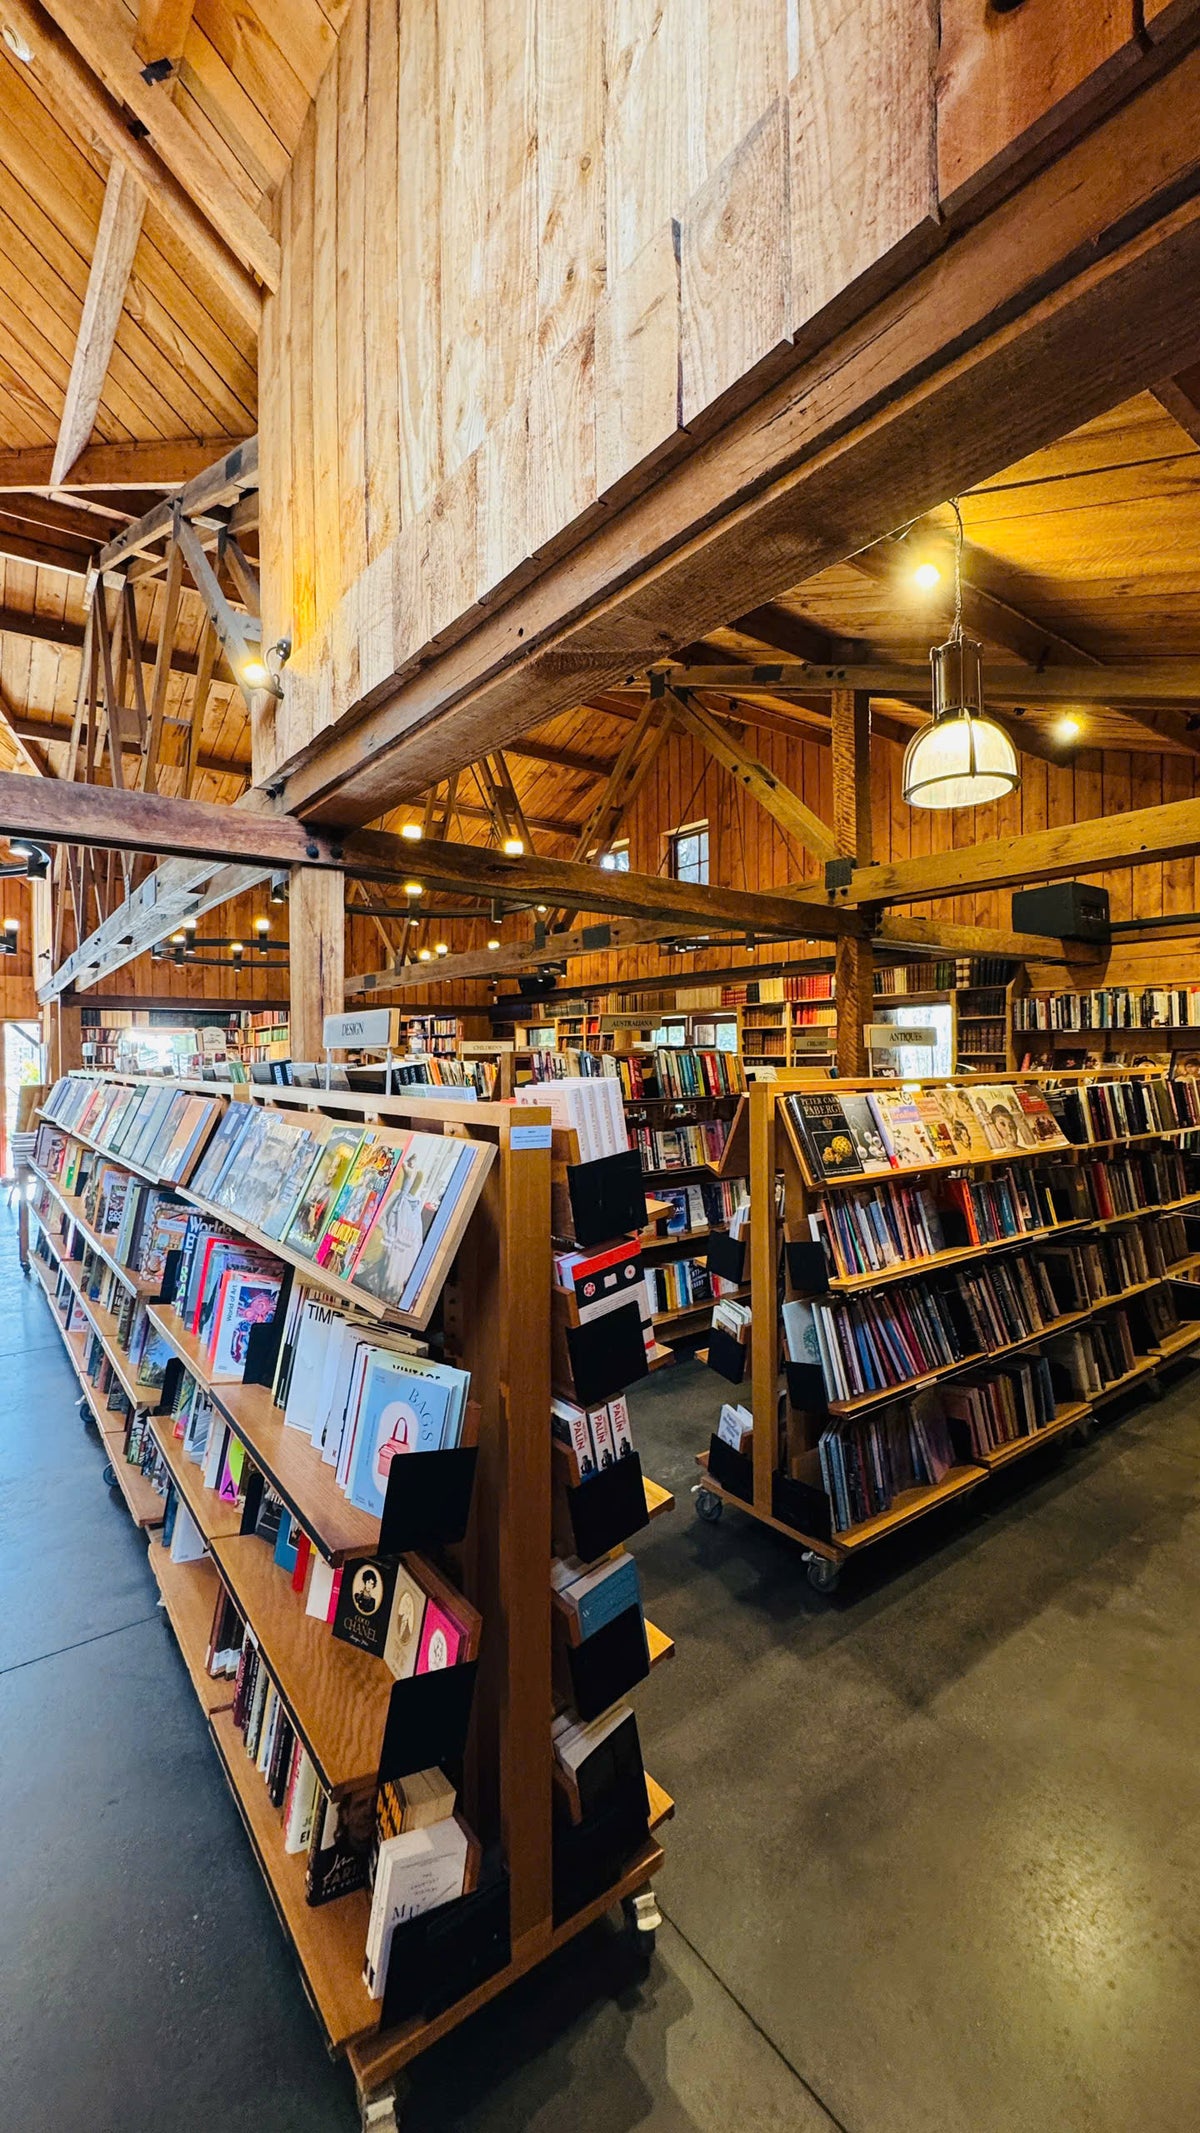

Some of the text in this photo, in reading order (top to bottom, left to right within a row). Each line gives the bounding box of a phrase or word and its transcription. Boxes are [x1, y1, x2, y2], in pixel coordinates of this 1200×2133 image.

[341, 1022, 364, 1036] DESIGN
[611, 1020, 653, 1028] AUSTRALIANA
[889, 1031, 924, 1042] ANTIQUES
[800, 1097, 822, 1106] PETER
[226, 1303, 235, 1322] World
[407, 1387, 434, 1442] BAGS
[613, 1403, 624, 1432] PALIN
[573, 1420, 585, 1451] PALIN
[594, 1414, 606, 1444] PALIN
[343, 1617, 378, 1643] CHANEL
[354, 1615, 370, 1627] COCO
